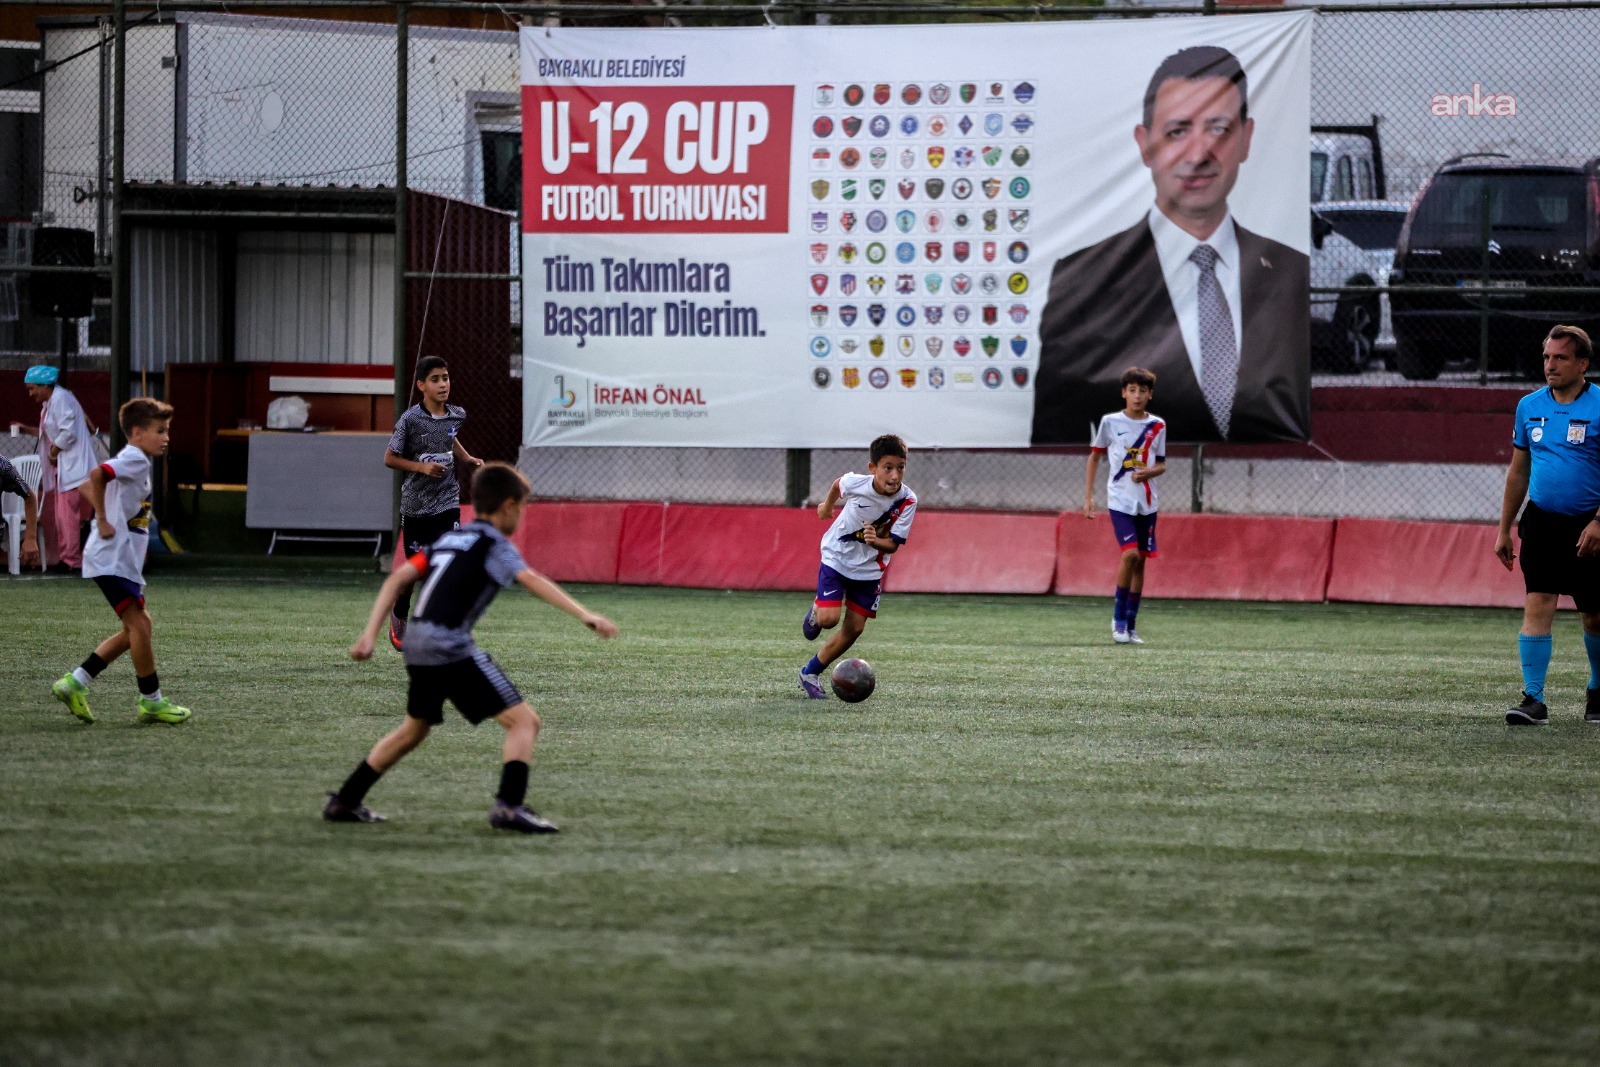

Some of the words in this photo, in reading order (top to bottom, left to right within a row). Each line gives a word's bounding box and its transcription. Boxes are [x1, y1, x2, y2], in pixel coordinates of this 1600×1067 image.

[538, 58, 601, 78] BAYRAKLI
[606, 55, 686, 78] BELEDİYESİ
[540, 100, 649, 175] U-12
[663, 100, 769, 175] CUP
[541, 185, 624, 221] FUTBOL
[629, 184, 767, 221] TURNUVASI
[543, 255, 594, 293] Tüm
[600, 257, 730, 293] Takımlara
[543, 301, 657, 348] Başarılar
[664, 299, 766, 337] Dilerim.
[594, 383, 647, 405] İRFAN
[653, 384, 706, 405] ÖNAL
